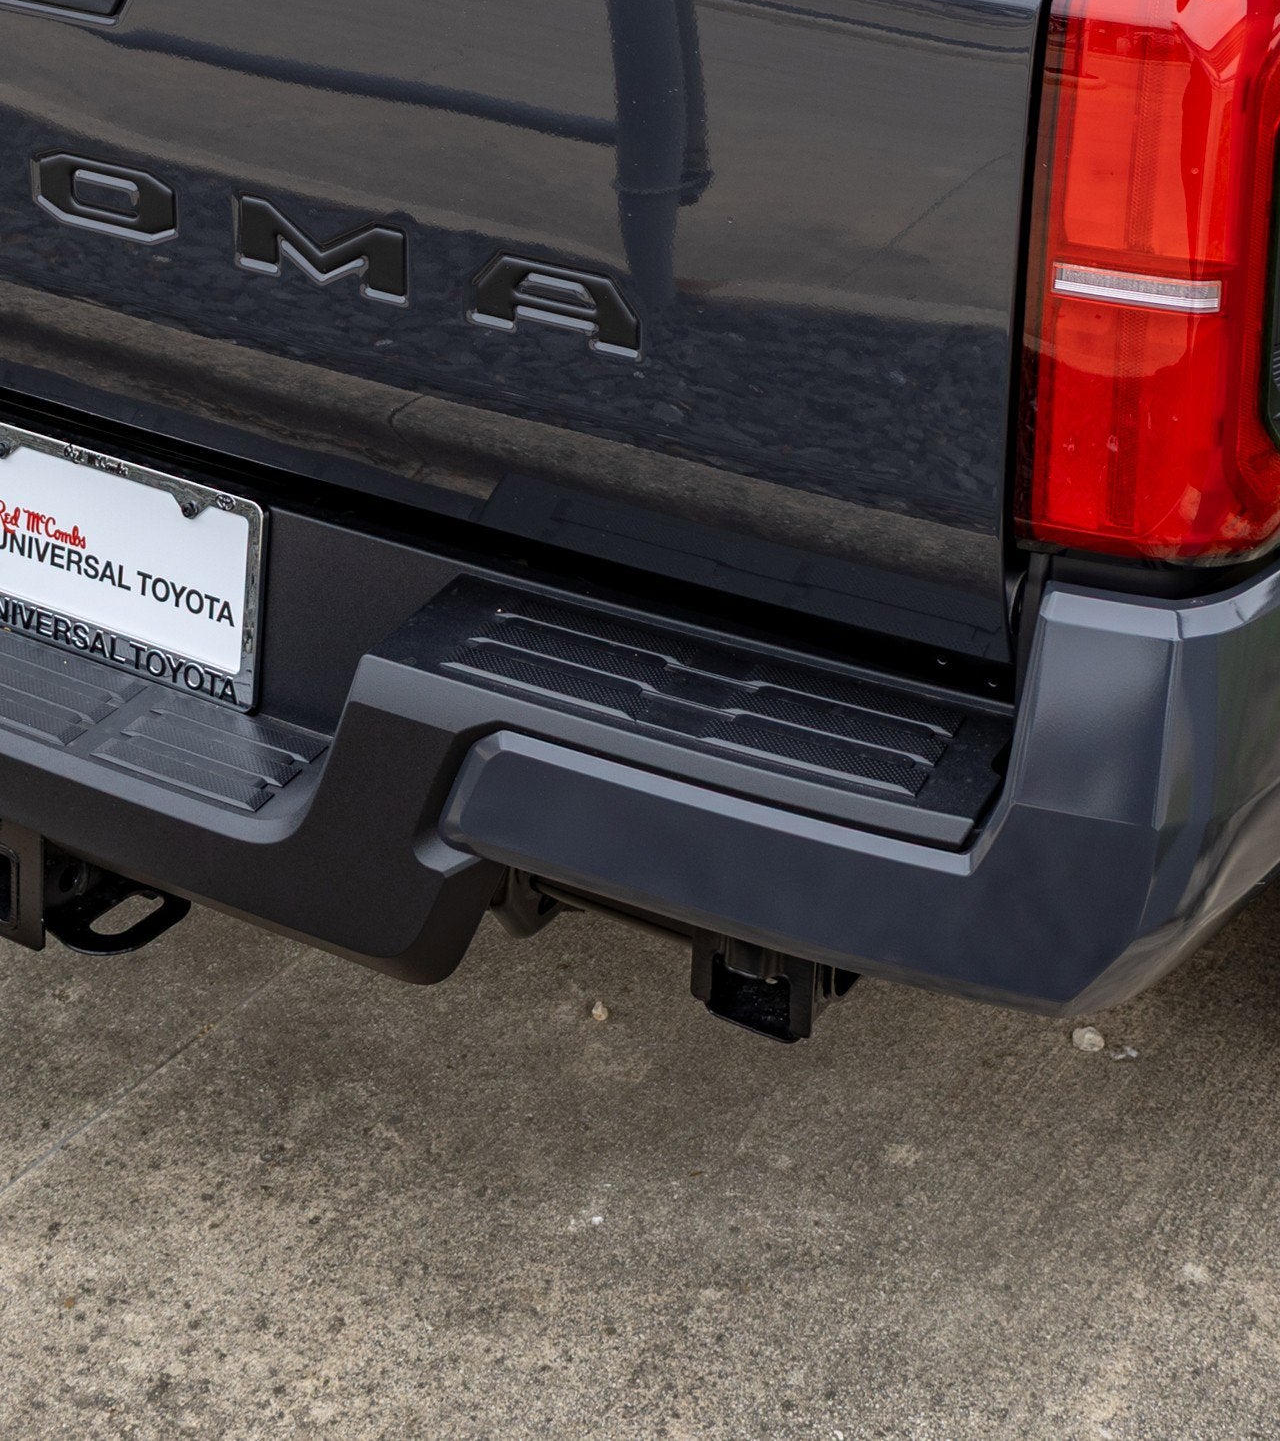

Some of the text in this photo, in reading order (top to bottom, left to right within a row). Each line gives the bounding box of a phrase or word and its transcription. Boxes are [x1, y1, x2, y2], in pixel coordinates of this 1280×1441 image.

[22, 507, 87, 550] McCombs
[136, 570, 235, 628] TOYOTA
[129, 641, 240, 706] TOYOTA
